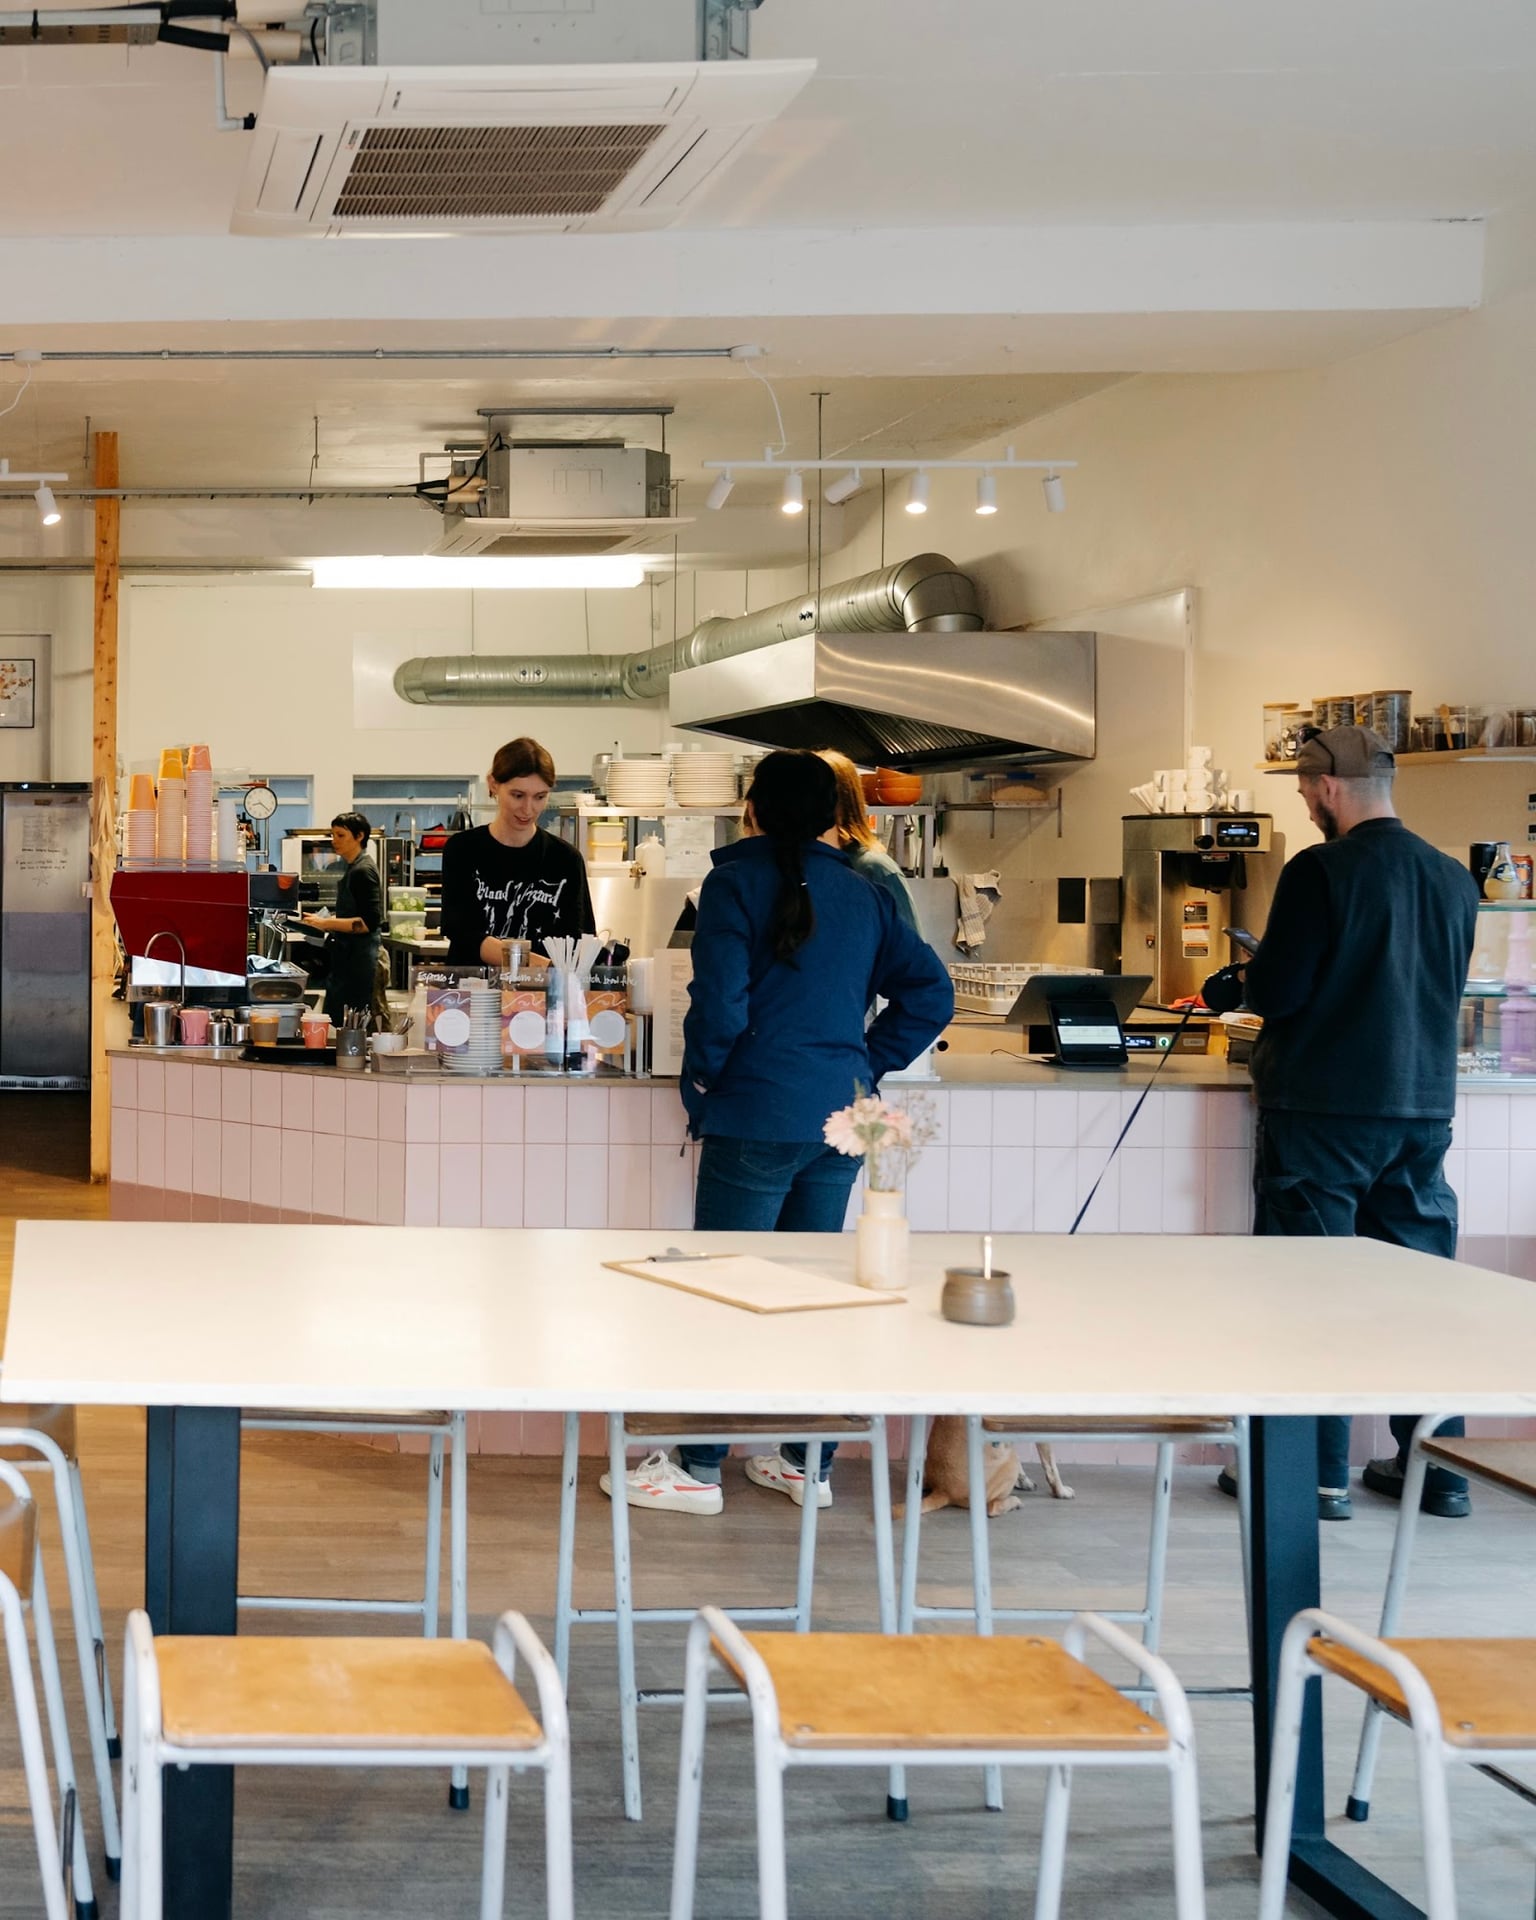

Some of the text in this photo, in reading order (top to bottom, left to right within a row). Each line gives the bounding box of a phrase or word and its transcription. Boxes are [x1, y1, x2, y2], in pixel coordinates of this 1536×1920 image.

[475, 878, 567, 906] Blood Wizard
[448, 973, 455, 985] 1
